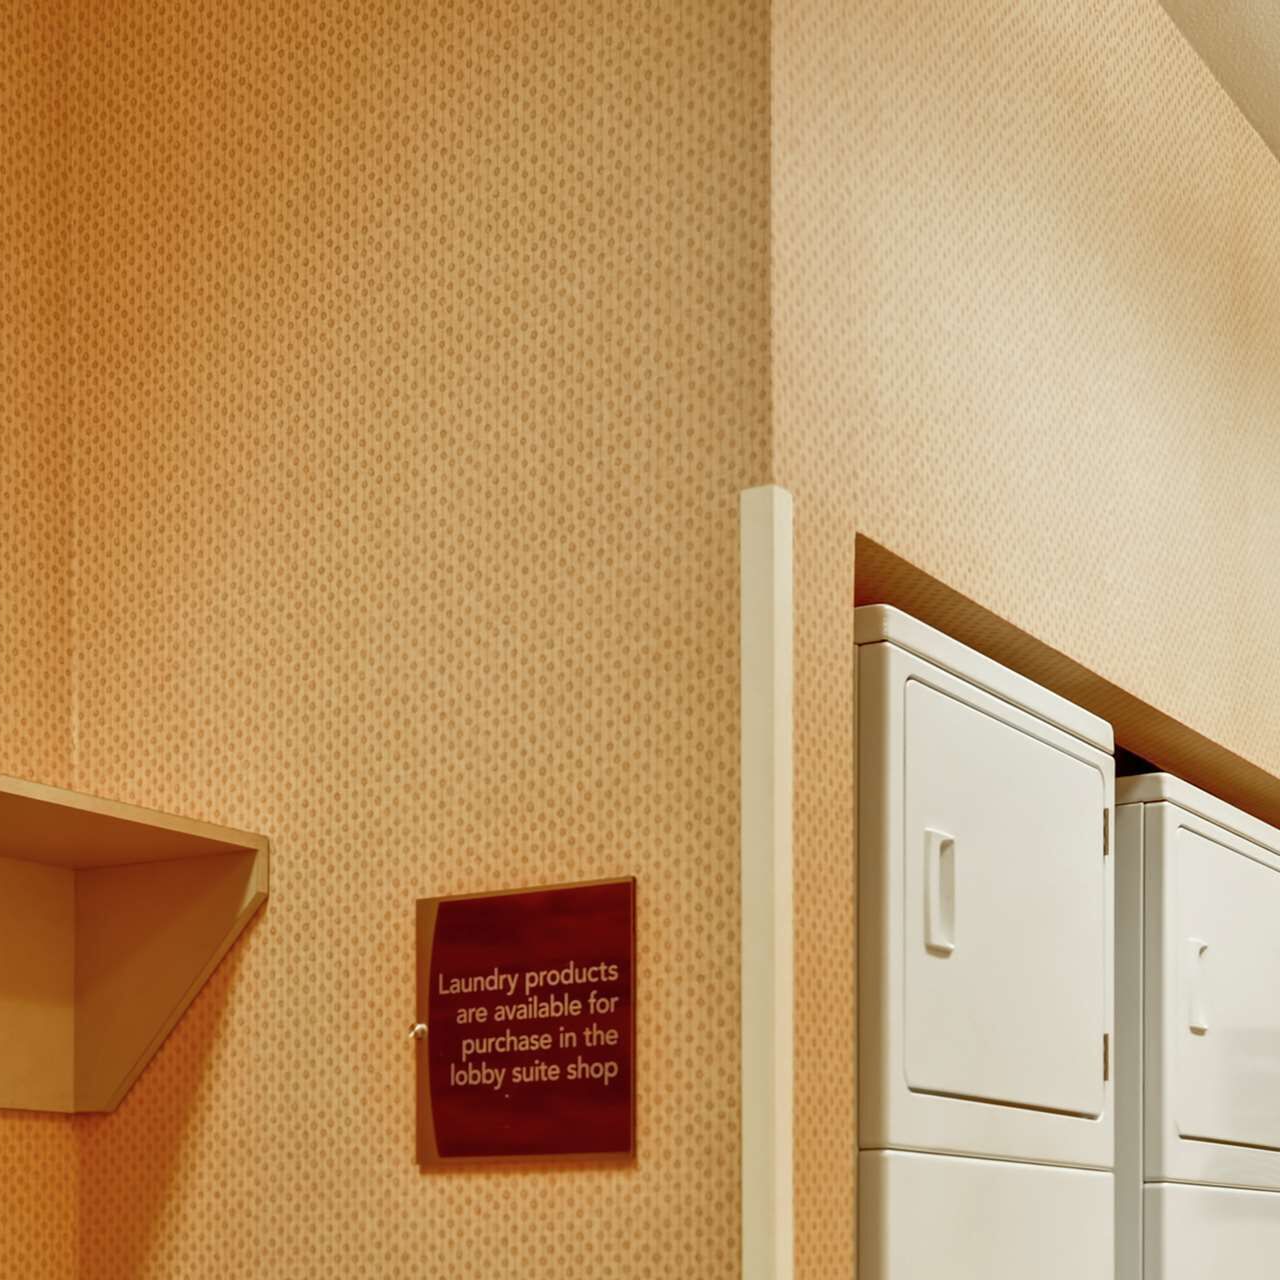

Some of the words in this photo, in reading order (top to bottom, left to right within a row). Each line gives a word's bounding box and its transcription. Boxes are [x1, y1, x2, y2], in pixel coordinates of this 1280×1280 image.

[439, 968, 518, 996] Laundry
[525, 960, 618, 995] products
[456, 1006, 488, 1024] are
[494, 993, 582, 1022] available
[588, 990, 619, 1014] for
[462, 1029, 552, 1062] purchase
[560, 1026, 576, 1048] in
[582, 1023, 618, 1046] the
[450, 1061, 505, 1090] lobby
[512, 1060, 560, 1083] suite
[566, 1056, 618, 1086] shop
